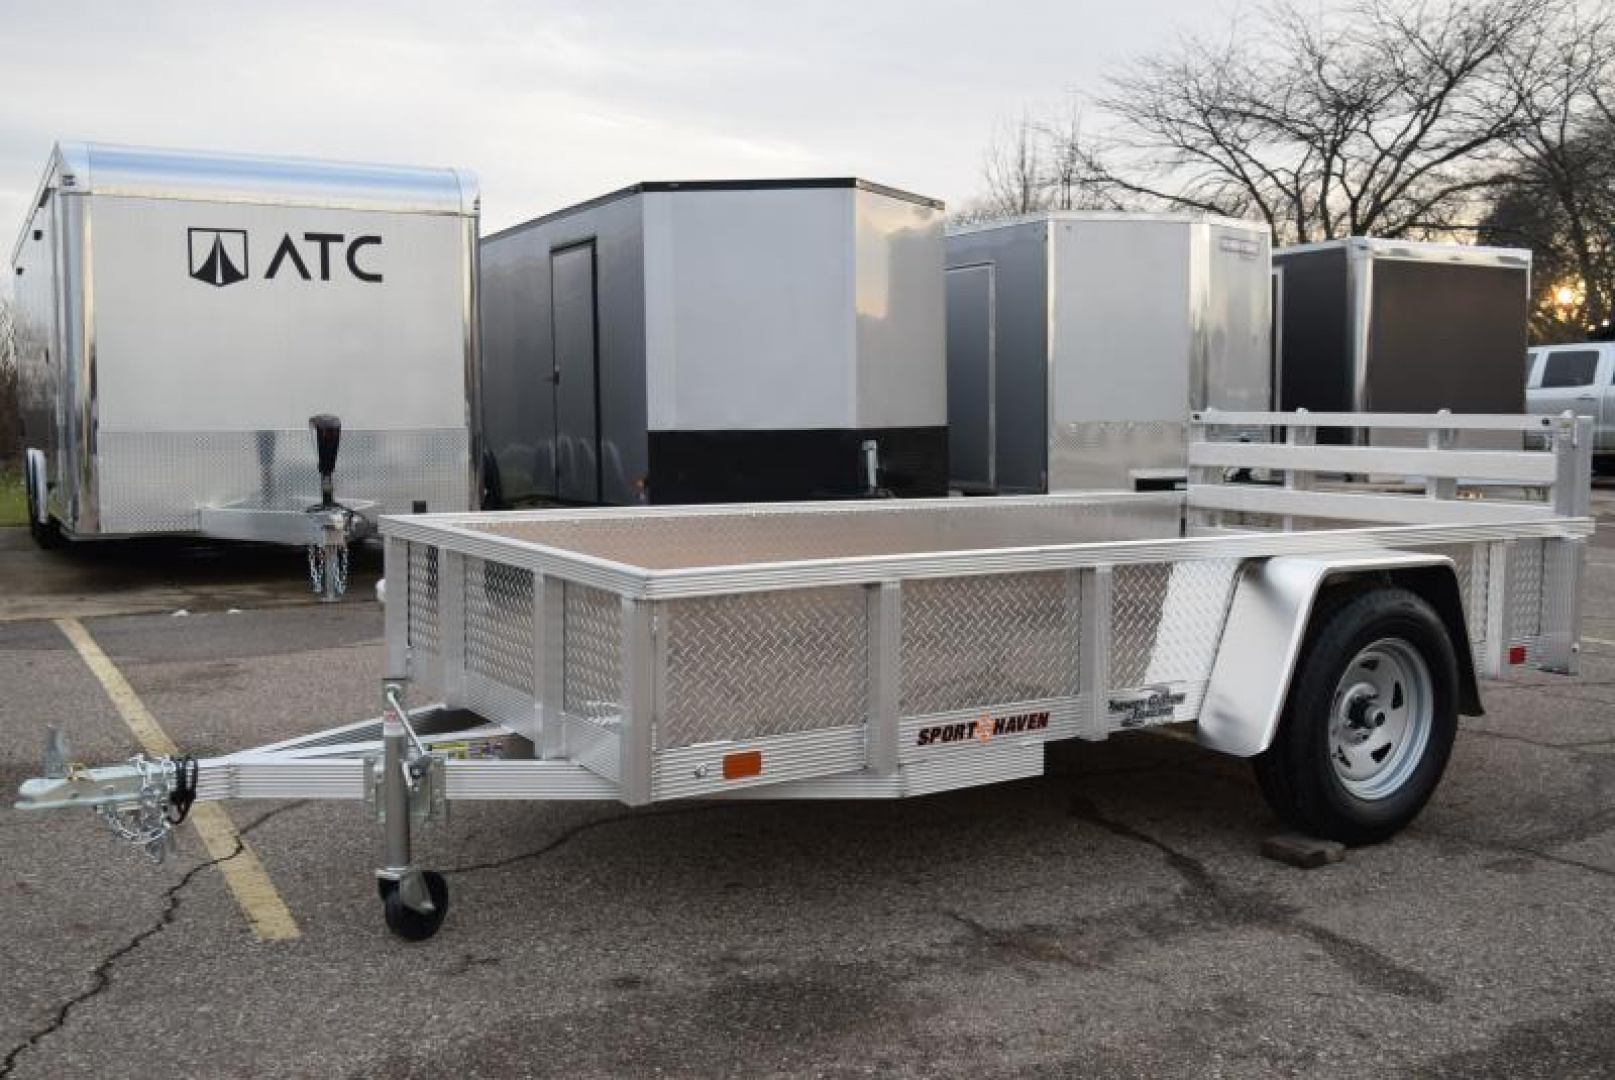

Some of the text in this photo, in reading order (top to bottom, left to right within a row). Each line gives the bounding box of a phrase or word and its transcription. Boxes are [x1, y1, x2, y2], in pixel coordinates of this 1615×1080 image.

[264, 232, 383, 283] ATC
[917, 712, 1050, 745] SPORT HAVEN
